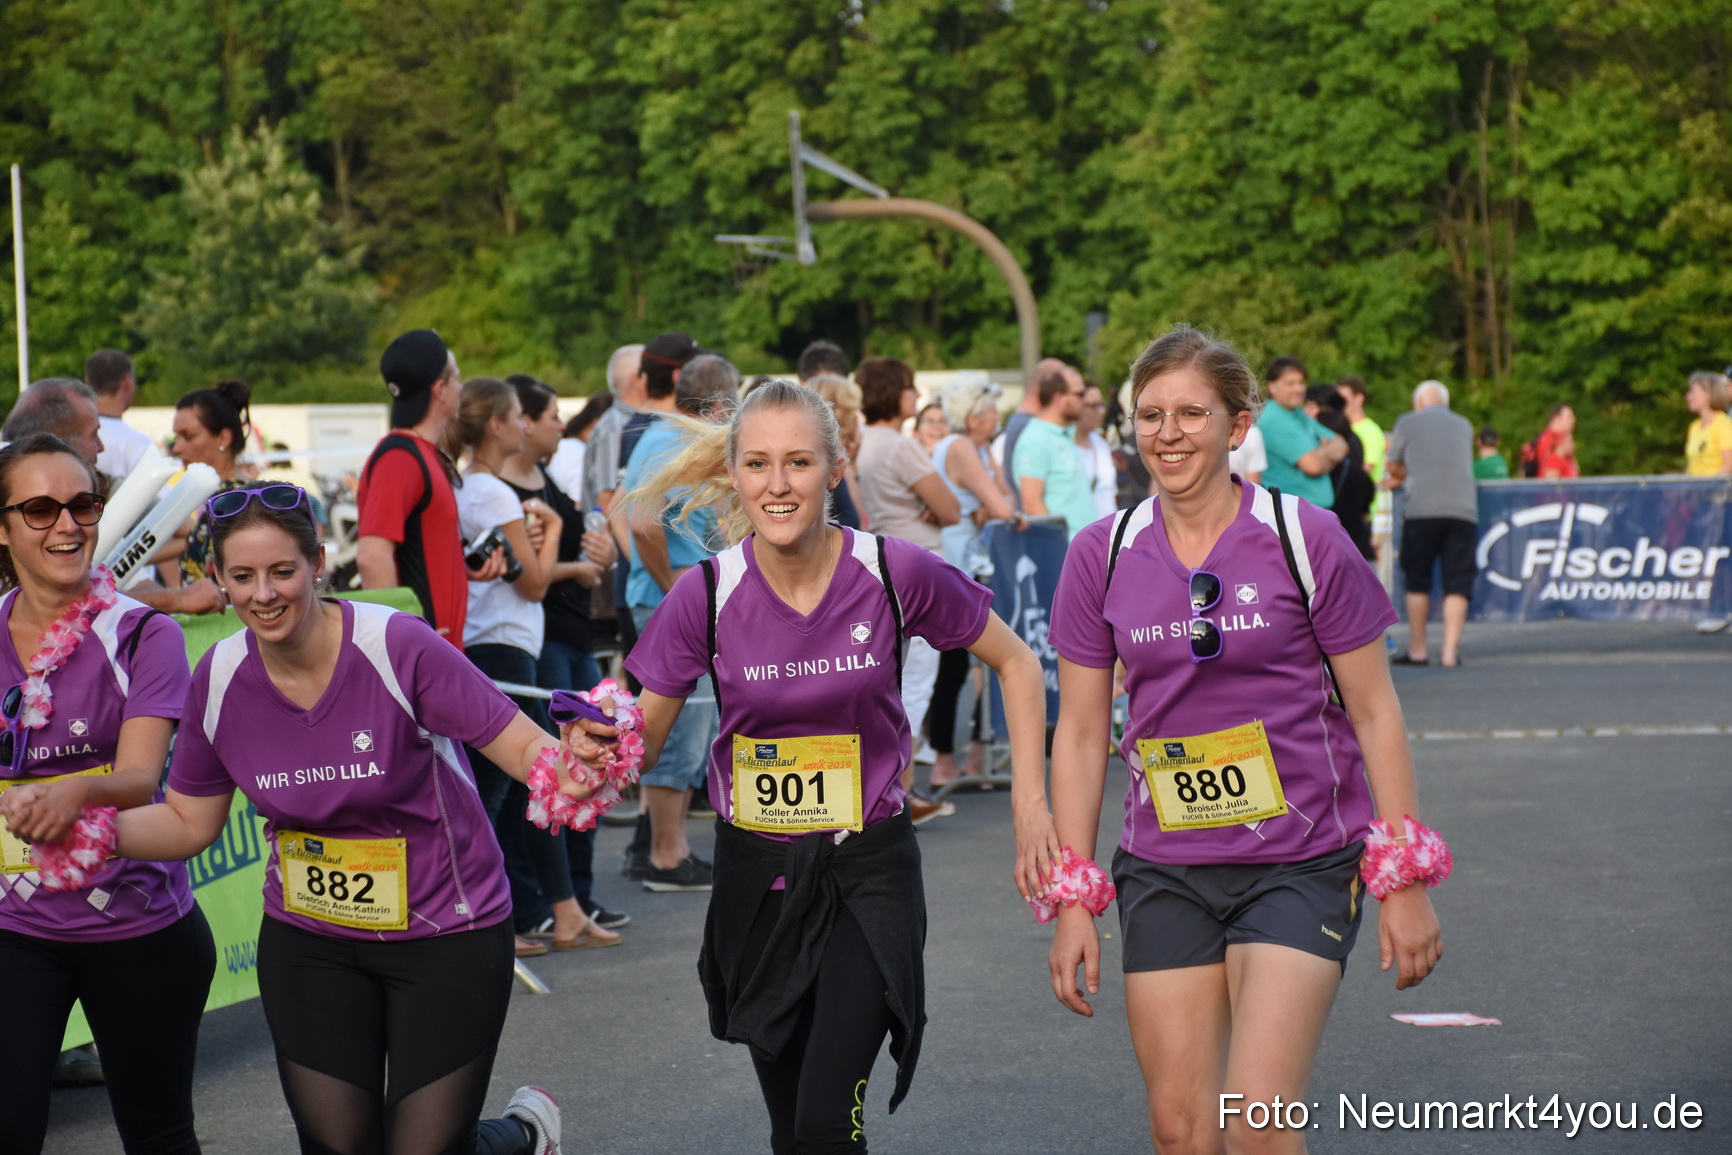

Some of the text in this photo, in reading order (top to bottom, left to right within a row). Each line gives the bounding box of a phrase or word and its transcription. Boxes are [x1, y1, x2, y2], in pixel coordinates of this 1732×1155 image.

[1520, 536, 1731, 579] Fischer
[1539, 581, 1713, 600] AUTOMOBILE
[1131, 612, 1270, 644] WIR SI LILA.
[743, 652, 880, 681] WIR SIND LILA.
[27, 746, 50, 760] ND
[55, 743, 98, 758] LILA.
[1160, 753, 1206, 766] firmenlauf
[1213, 748, 1262, 766] walk 2019
[746, 756, 797, 767] firmenlauf
[803, 759, 852, 770] walk 2019
[255, 761, 385, 790] WIR SIND LILA.
[1174, 765, 1247, 803] 880
[756, 771, 824, 806] 901
[761, 807, 828, 816] Koller Annika
[1186, 799, 1249, 814] Broisch Julia
[1233, 806, 1259, 816] Service
[755, 816, 778, 824] FUCHS
[296, 848, 342, 865] firmenlauf
[372, 863, 397, 872] 2019
[307, 865, 375, 904] 882
[297, 892, 390, 914] Dietrich Ann-Kathrin
